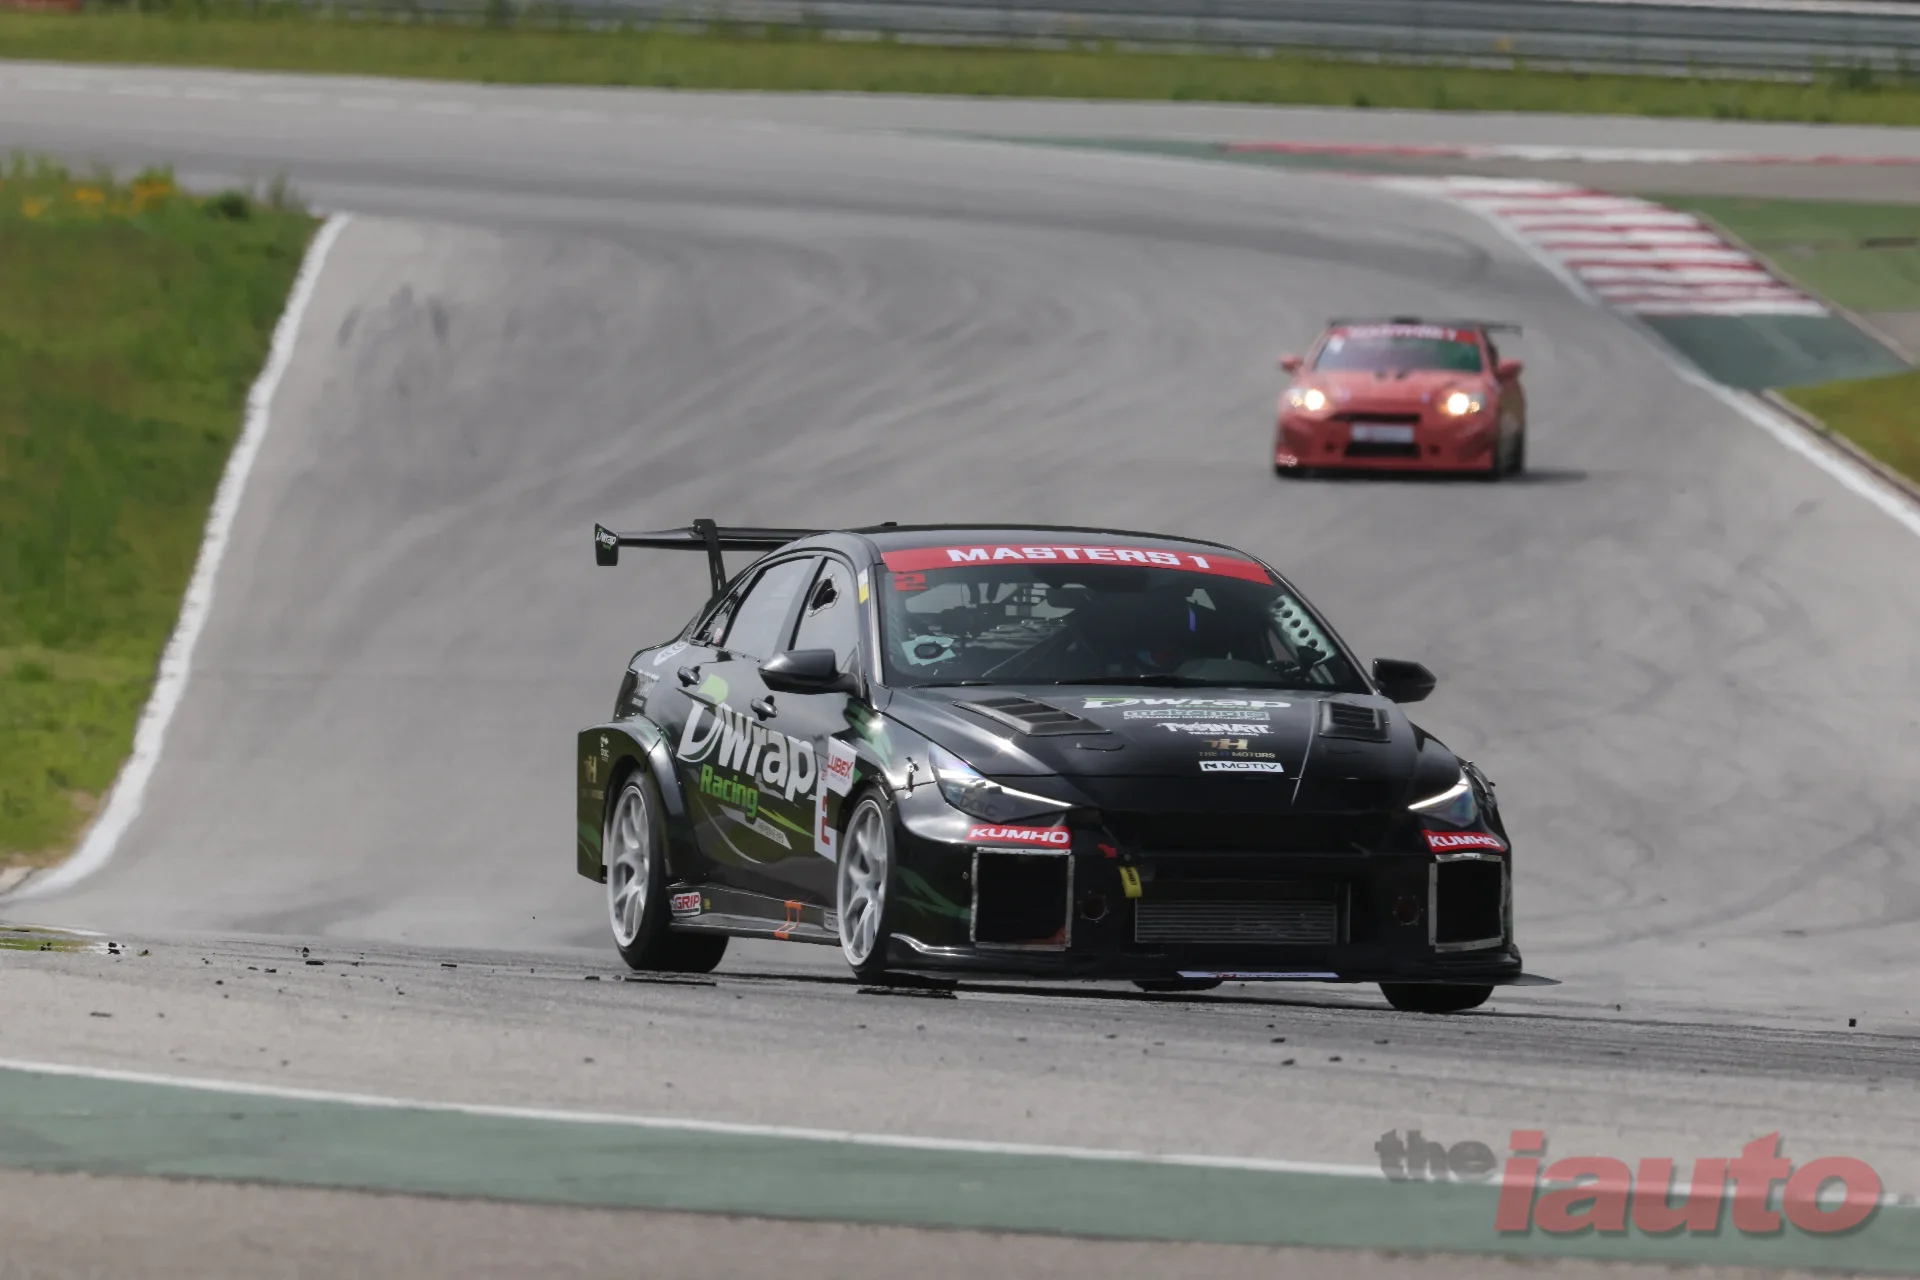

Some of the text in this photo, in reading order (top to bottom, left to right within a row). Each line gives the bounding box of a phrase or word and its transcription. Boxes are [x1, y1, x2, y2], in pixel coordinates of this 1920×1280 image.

[946, 546, 1211, 569] MASTERS 1
[894, 573, 927, 591] 2
[676, 673, 816, 802] Dwrap
[827, 753, 854, 779] LUBEX
[1221, 762, 1278, 770] MOTIV
[700, 763, 759, 819] Racing
[969, 827, 1070, 845] KUMHO
[1427, 834, 1501, 849] KUMHO
